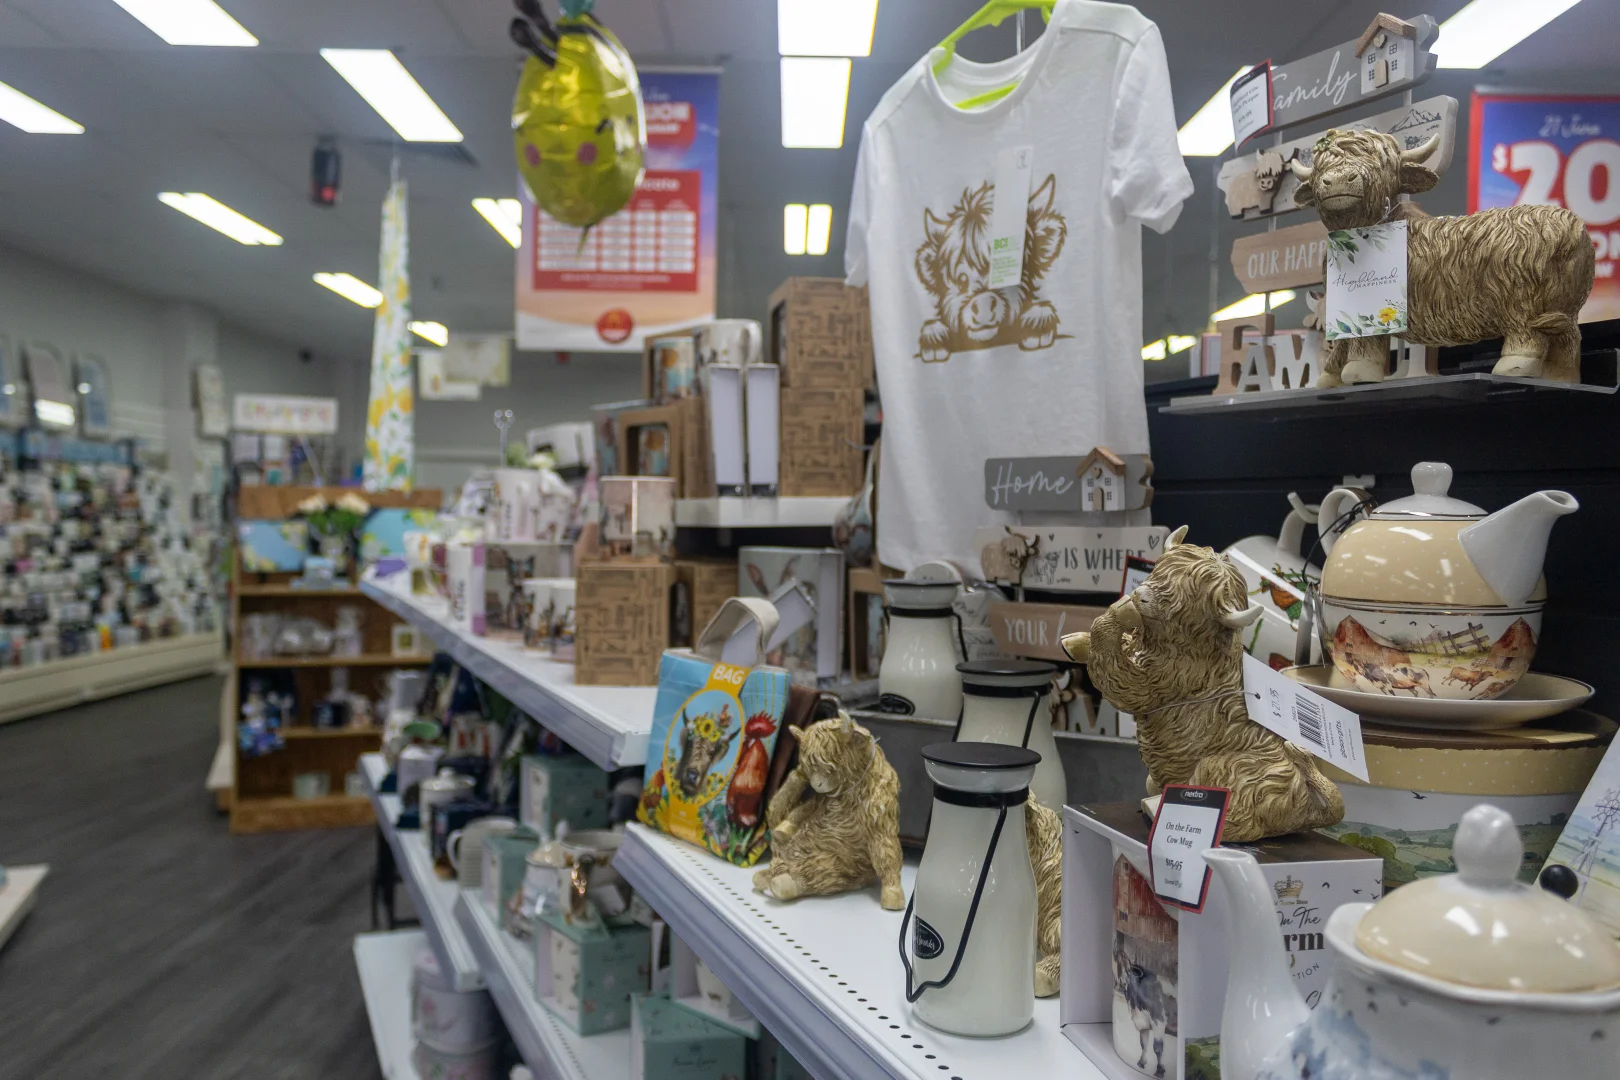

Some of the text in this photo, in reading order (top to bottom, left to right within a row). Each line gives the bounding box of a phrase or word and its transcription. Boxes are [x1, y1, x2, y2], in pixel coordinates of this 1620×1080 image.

[1561, 115, 1600, 138] June
[1247, 240, 1327, 279] OUR HAPP
[1332, 267, 1399, 292] Highland
[1356, 279, 1397, 288] HAPPINESS
[991, 461, 1074, 505] Home
[1064, 547, 1079, 570] IS
[1004, 617, 1049, 646] YOUR
[713, 664, 745, 685] BAG
[1184, 790, 1204, 799] nextra
[1165, 821, 1202, 835] On the Farm
[1166, 835, 1193, 849] Cow Mug
[1292, 906, 1322, 929] The
[1283, 932, 1325, 952] rm
[1292, 962, 1320, 980] TION
